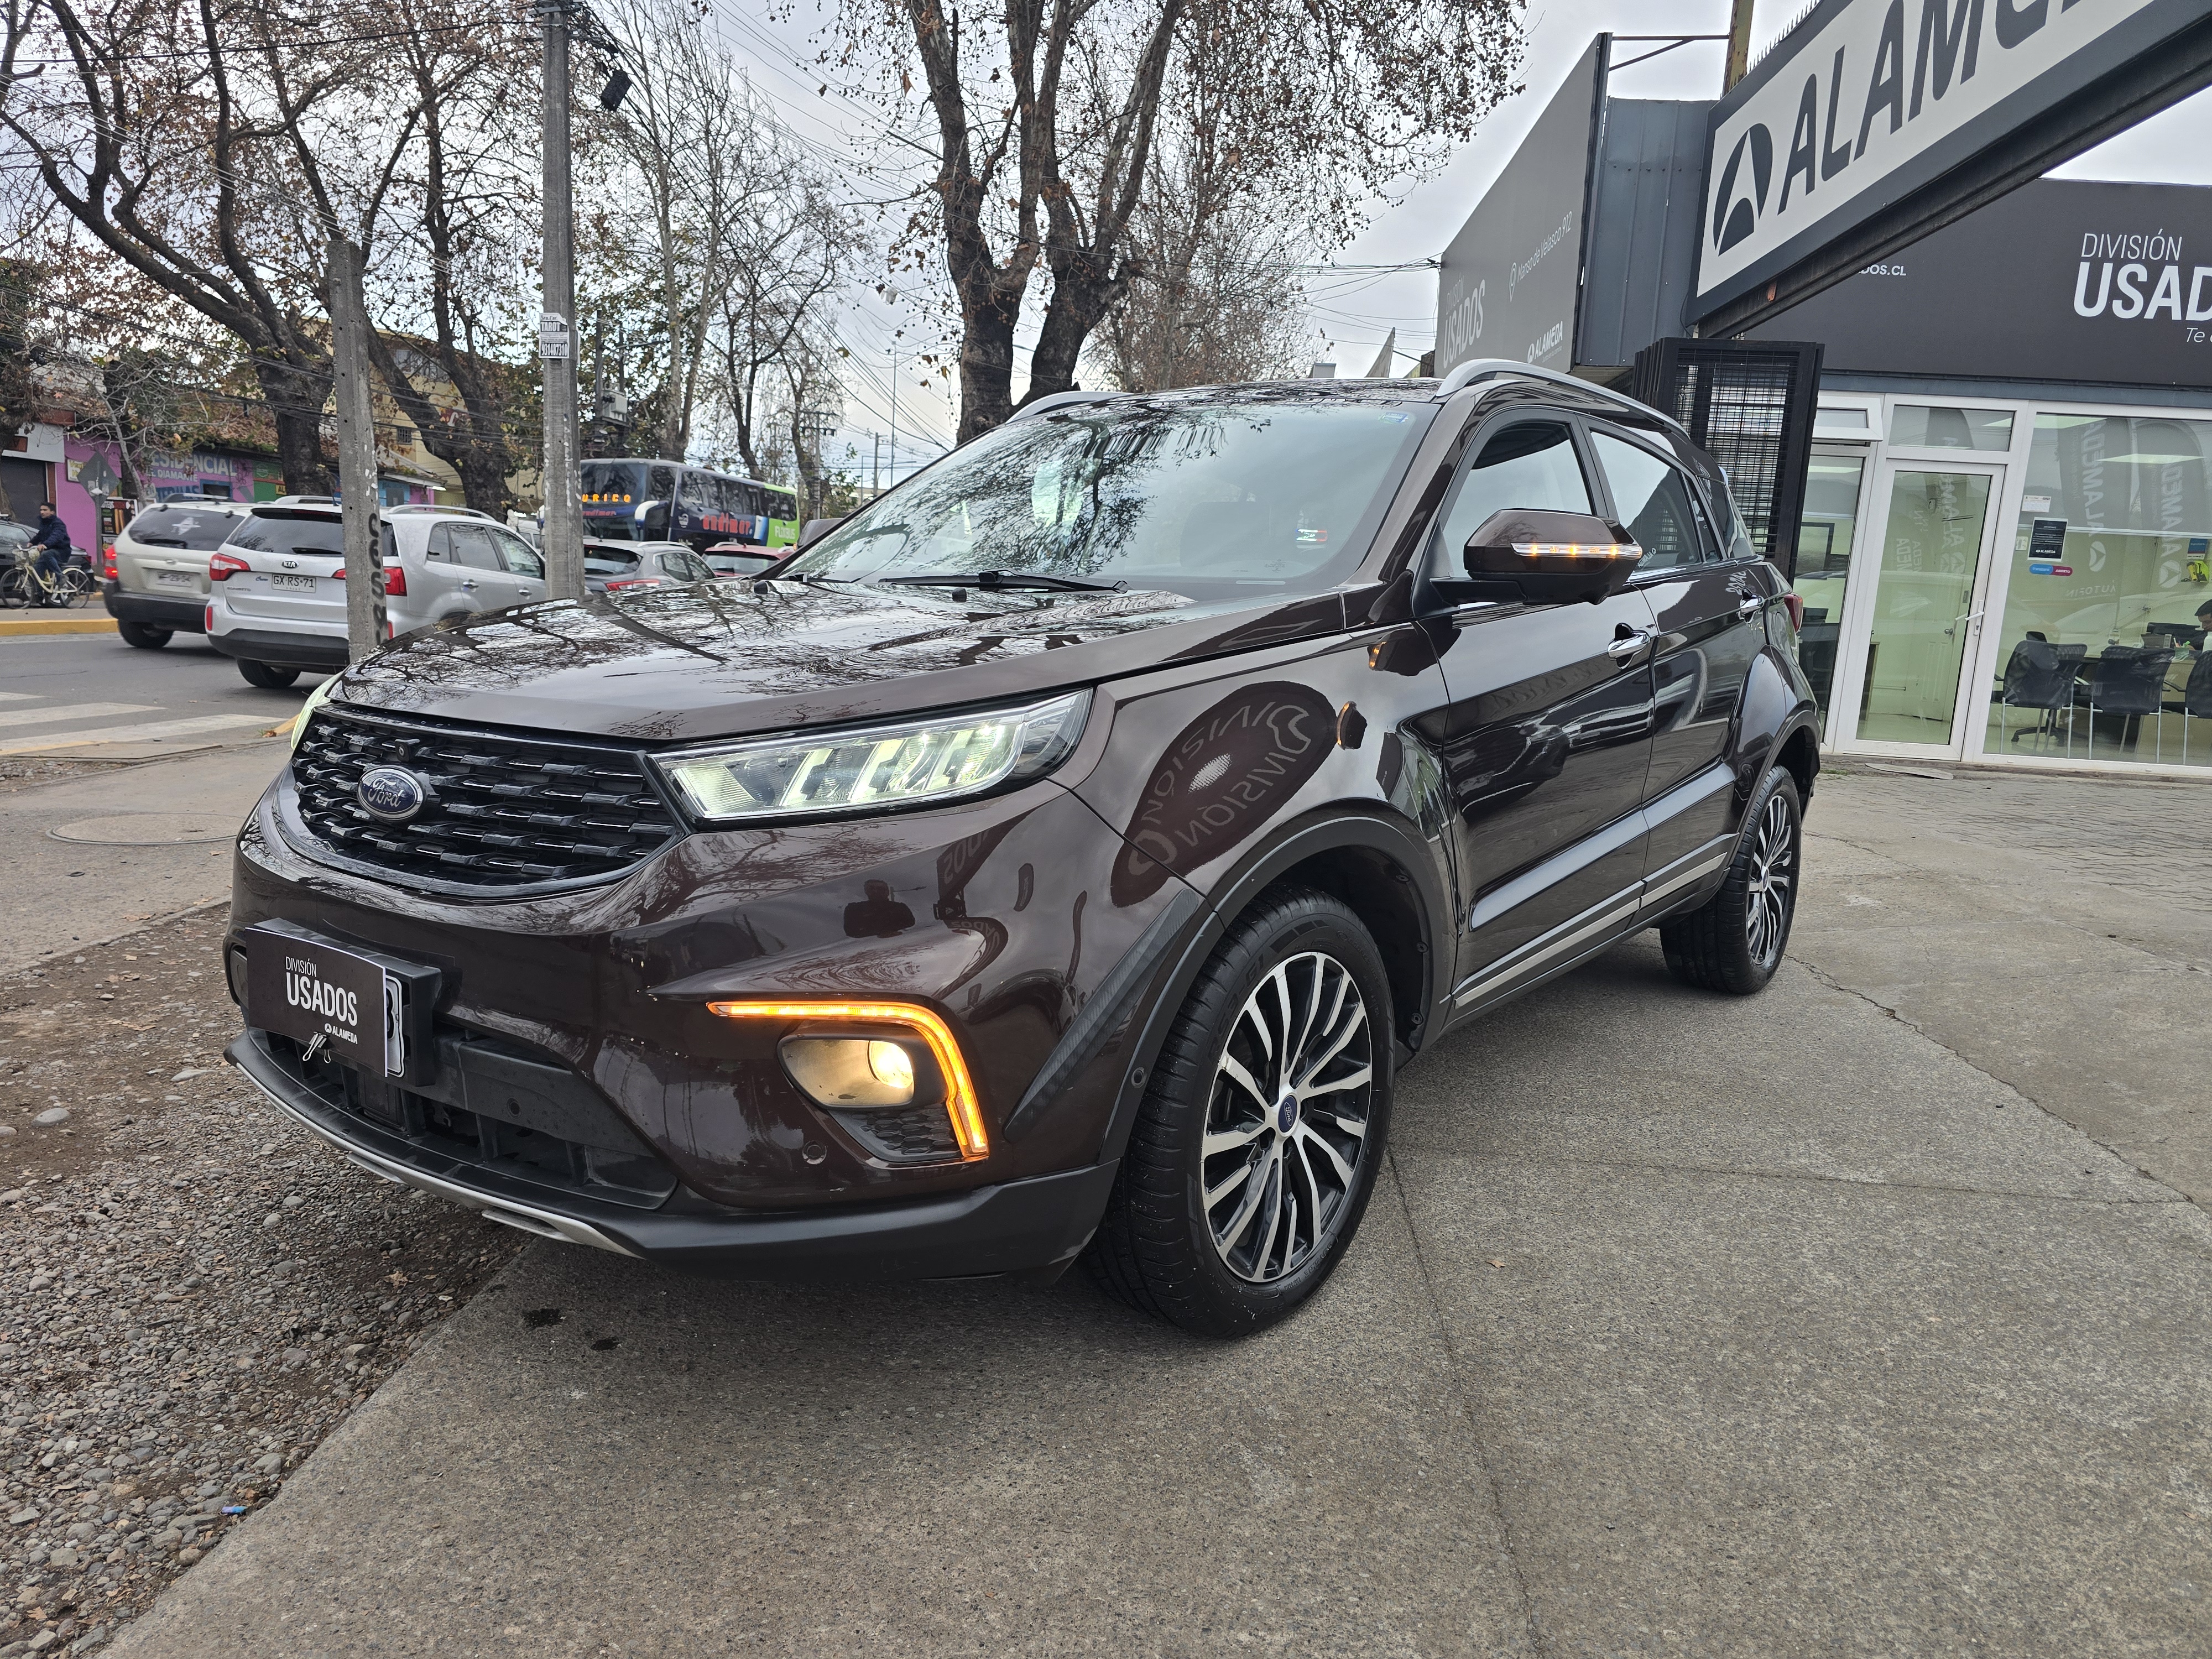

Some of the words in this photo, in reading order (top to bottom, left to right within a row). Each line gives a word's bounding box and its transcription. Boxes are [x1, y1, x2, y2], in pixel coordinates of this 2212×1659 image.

[1777, 0, 2083, 216] ALAM
[1517, 256, 1532, 282] Manso
[1533, 247, 1540, 267] de
[1541, 226, 1562, 258] Velasco
[1562, 211, 1572, 237] 912
[2081, 228, 2182, 261] DIVISIÓN
[1859, 264, 1907, 276] DOS.CL
[2074, 262, 2212, 321] USAD
[541, 321, 561, 332] TAROT
[1443, 279, 1485, 369] USADOS
[1534, 320, 1563, 359] ALAMEDA
[2187, 327, 2205, 343] Te
[142, 451, 237, 477] ESIDENCIAL
[367, 778, 401, 807] Ford
[285, 956, 317, 978] DIVISIÓN
[286, 972, 358, 1026] USADOS
[332, 1028, 358, 1045] ALAMEDA
